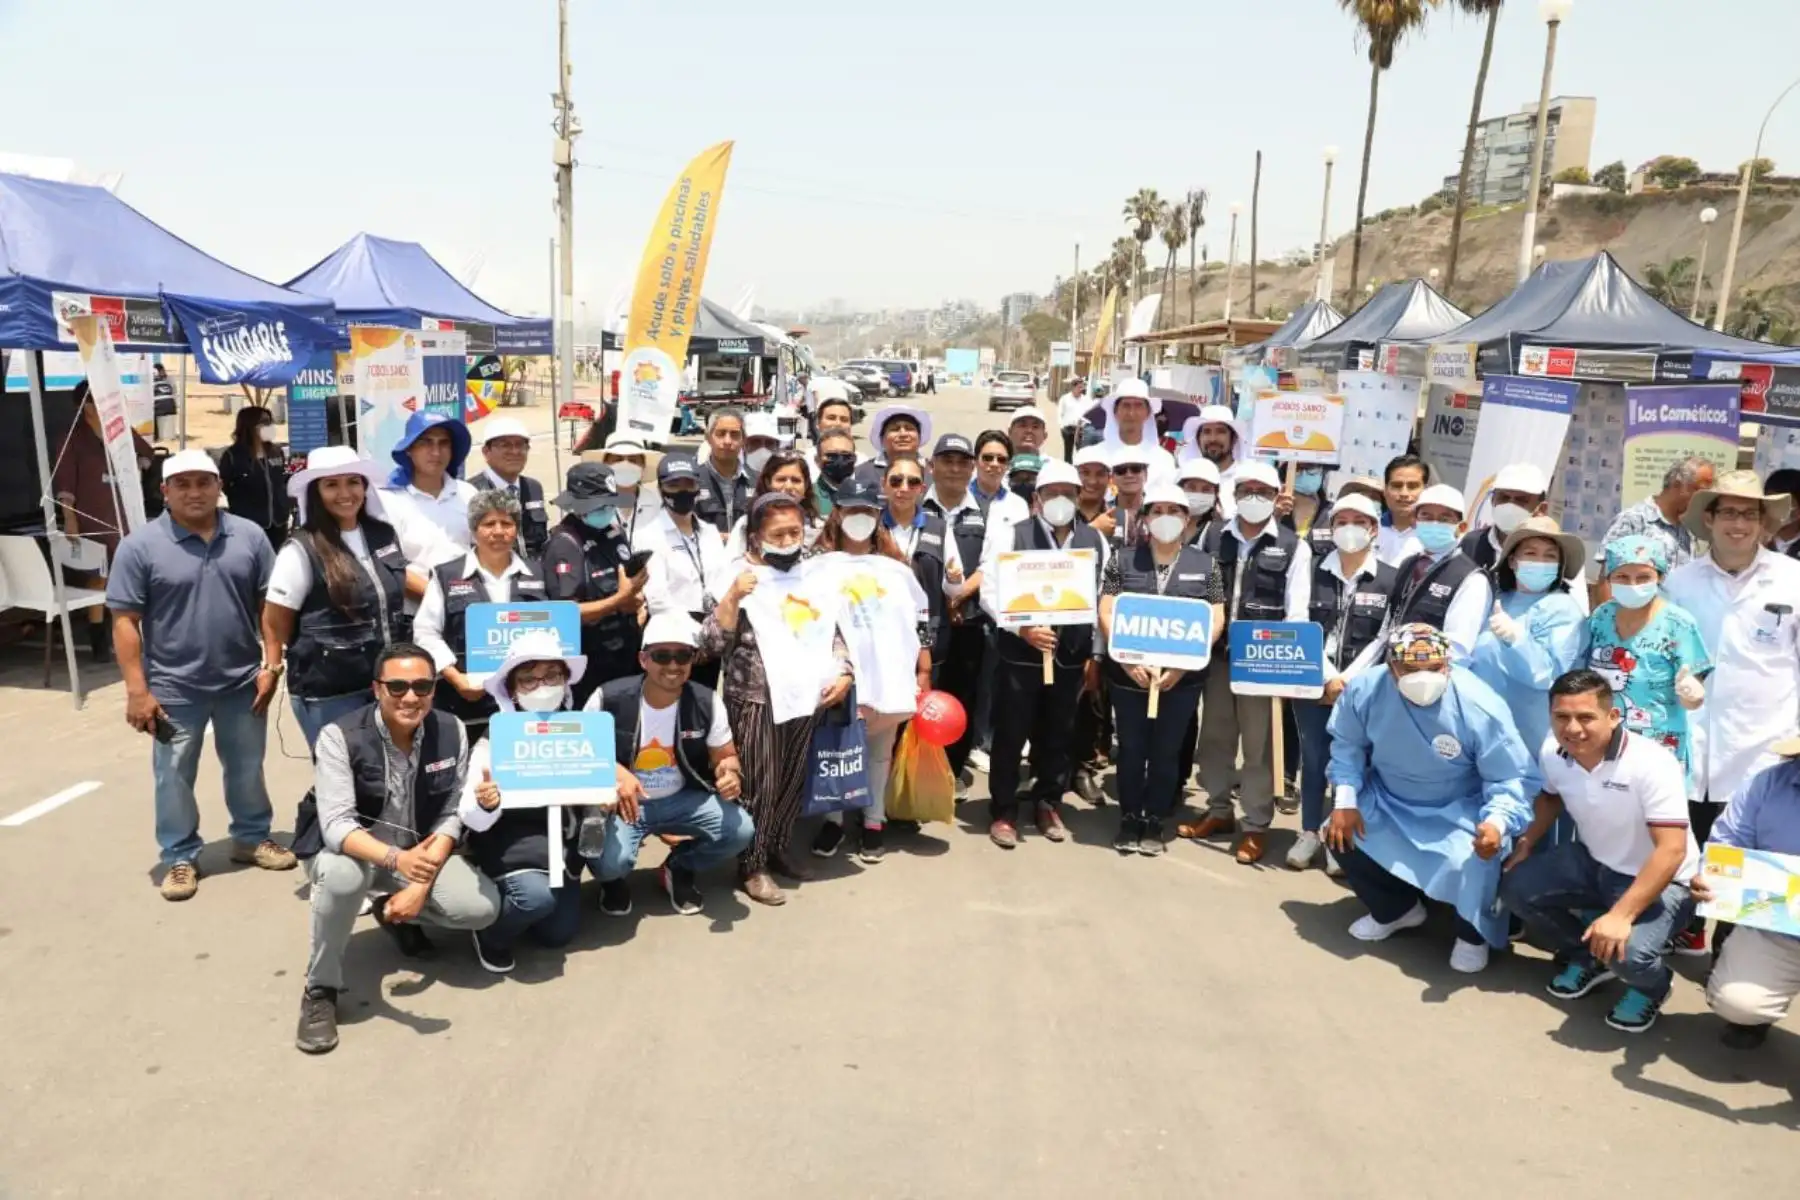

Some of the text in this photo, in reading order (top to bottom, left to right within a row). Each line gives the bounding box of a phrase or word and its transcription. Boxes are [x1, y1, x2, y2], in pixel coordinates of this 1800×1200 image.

[646, 177, 692, 341] Acude solo a piscinas
[670, 190, 711, 338] y playas saludables
[202, 321, 293, 381] SALUDABLE
[718, 339, 749, 348] MINSA
[292, 369, 336, 385] MINS
[425, 383, 460, 404] MINSA
[1638, 406, 1657, 423] Los
[1116, 613, 1205, 642] MINSA
[1245, 644, 1306, 660] DIGESA
[513, 740, 596, 759] DIGESA
[819, 754, 863, 777] Salud
